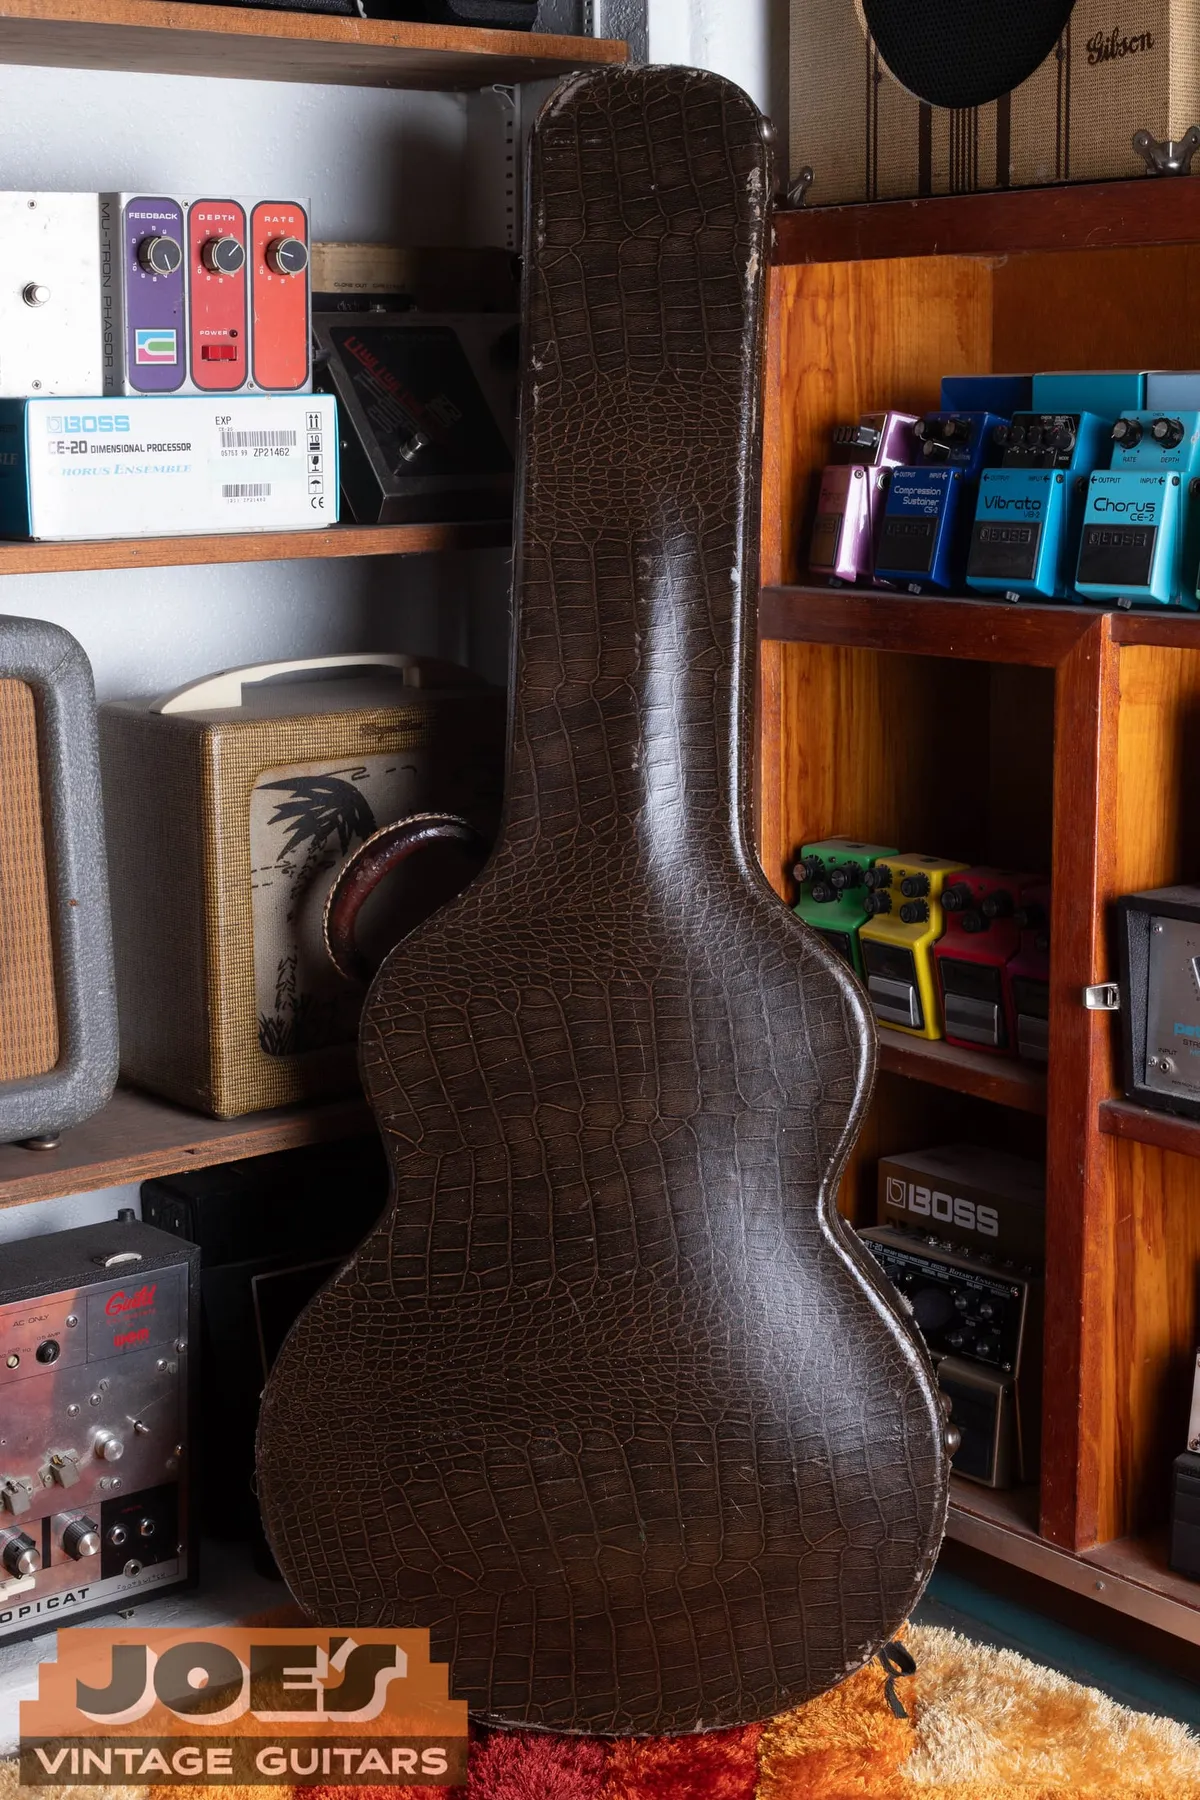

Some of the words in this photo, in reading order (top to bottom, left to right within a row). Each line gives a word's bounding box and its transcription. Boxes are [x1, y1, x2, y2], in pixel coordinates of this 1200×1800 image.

[1086, 26, 1155, 65] Gibson
[128, 212, 178, 220] FEEDBACK
[101, 202, 112, 288] MU-TRON
[103, 296, 114, 368] PHASOR
[105, 375, 114, 387] II
[64, 415, 130, 433] BOSS
[215, 416, 232, 426] EXP
[310, 434, 320, 443] 10
[48, 440, 88, 454] CE-20
[90, 444, 145, 454] DIMENSIONAL
[146, 442, 192, 453] PROCESSOR
[253, 447, 290, 457] ZP21462
[114, 463, 192, 476] ENSEMBLE
[893, 485, 941, 496] Compression
[902, 496, 940, 506] Sustainer
[984, 495, 1041, 510] Vibrato
[1093, 497, 1156, 512] Chorus
[923, 506, 938, 514] CS-2
[1129, 513, 1154, 521] CE-2
[908, 1183, 999, 1238] BOSS
[104, 1283, 157, 1317] Guild
[12, 1320, 25, 1328] AC
[28, 1314, 50, 1324] ONLY
[0, 1587, 90, 1623] OPICAT
